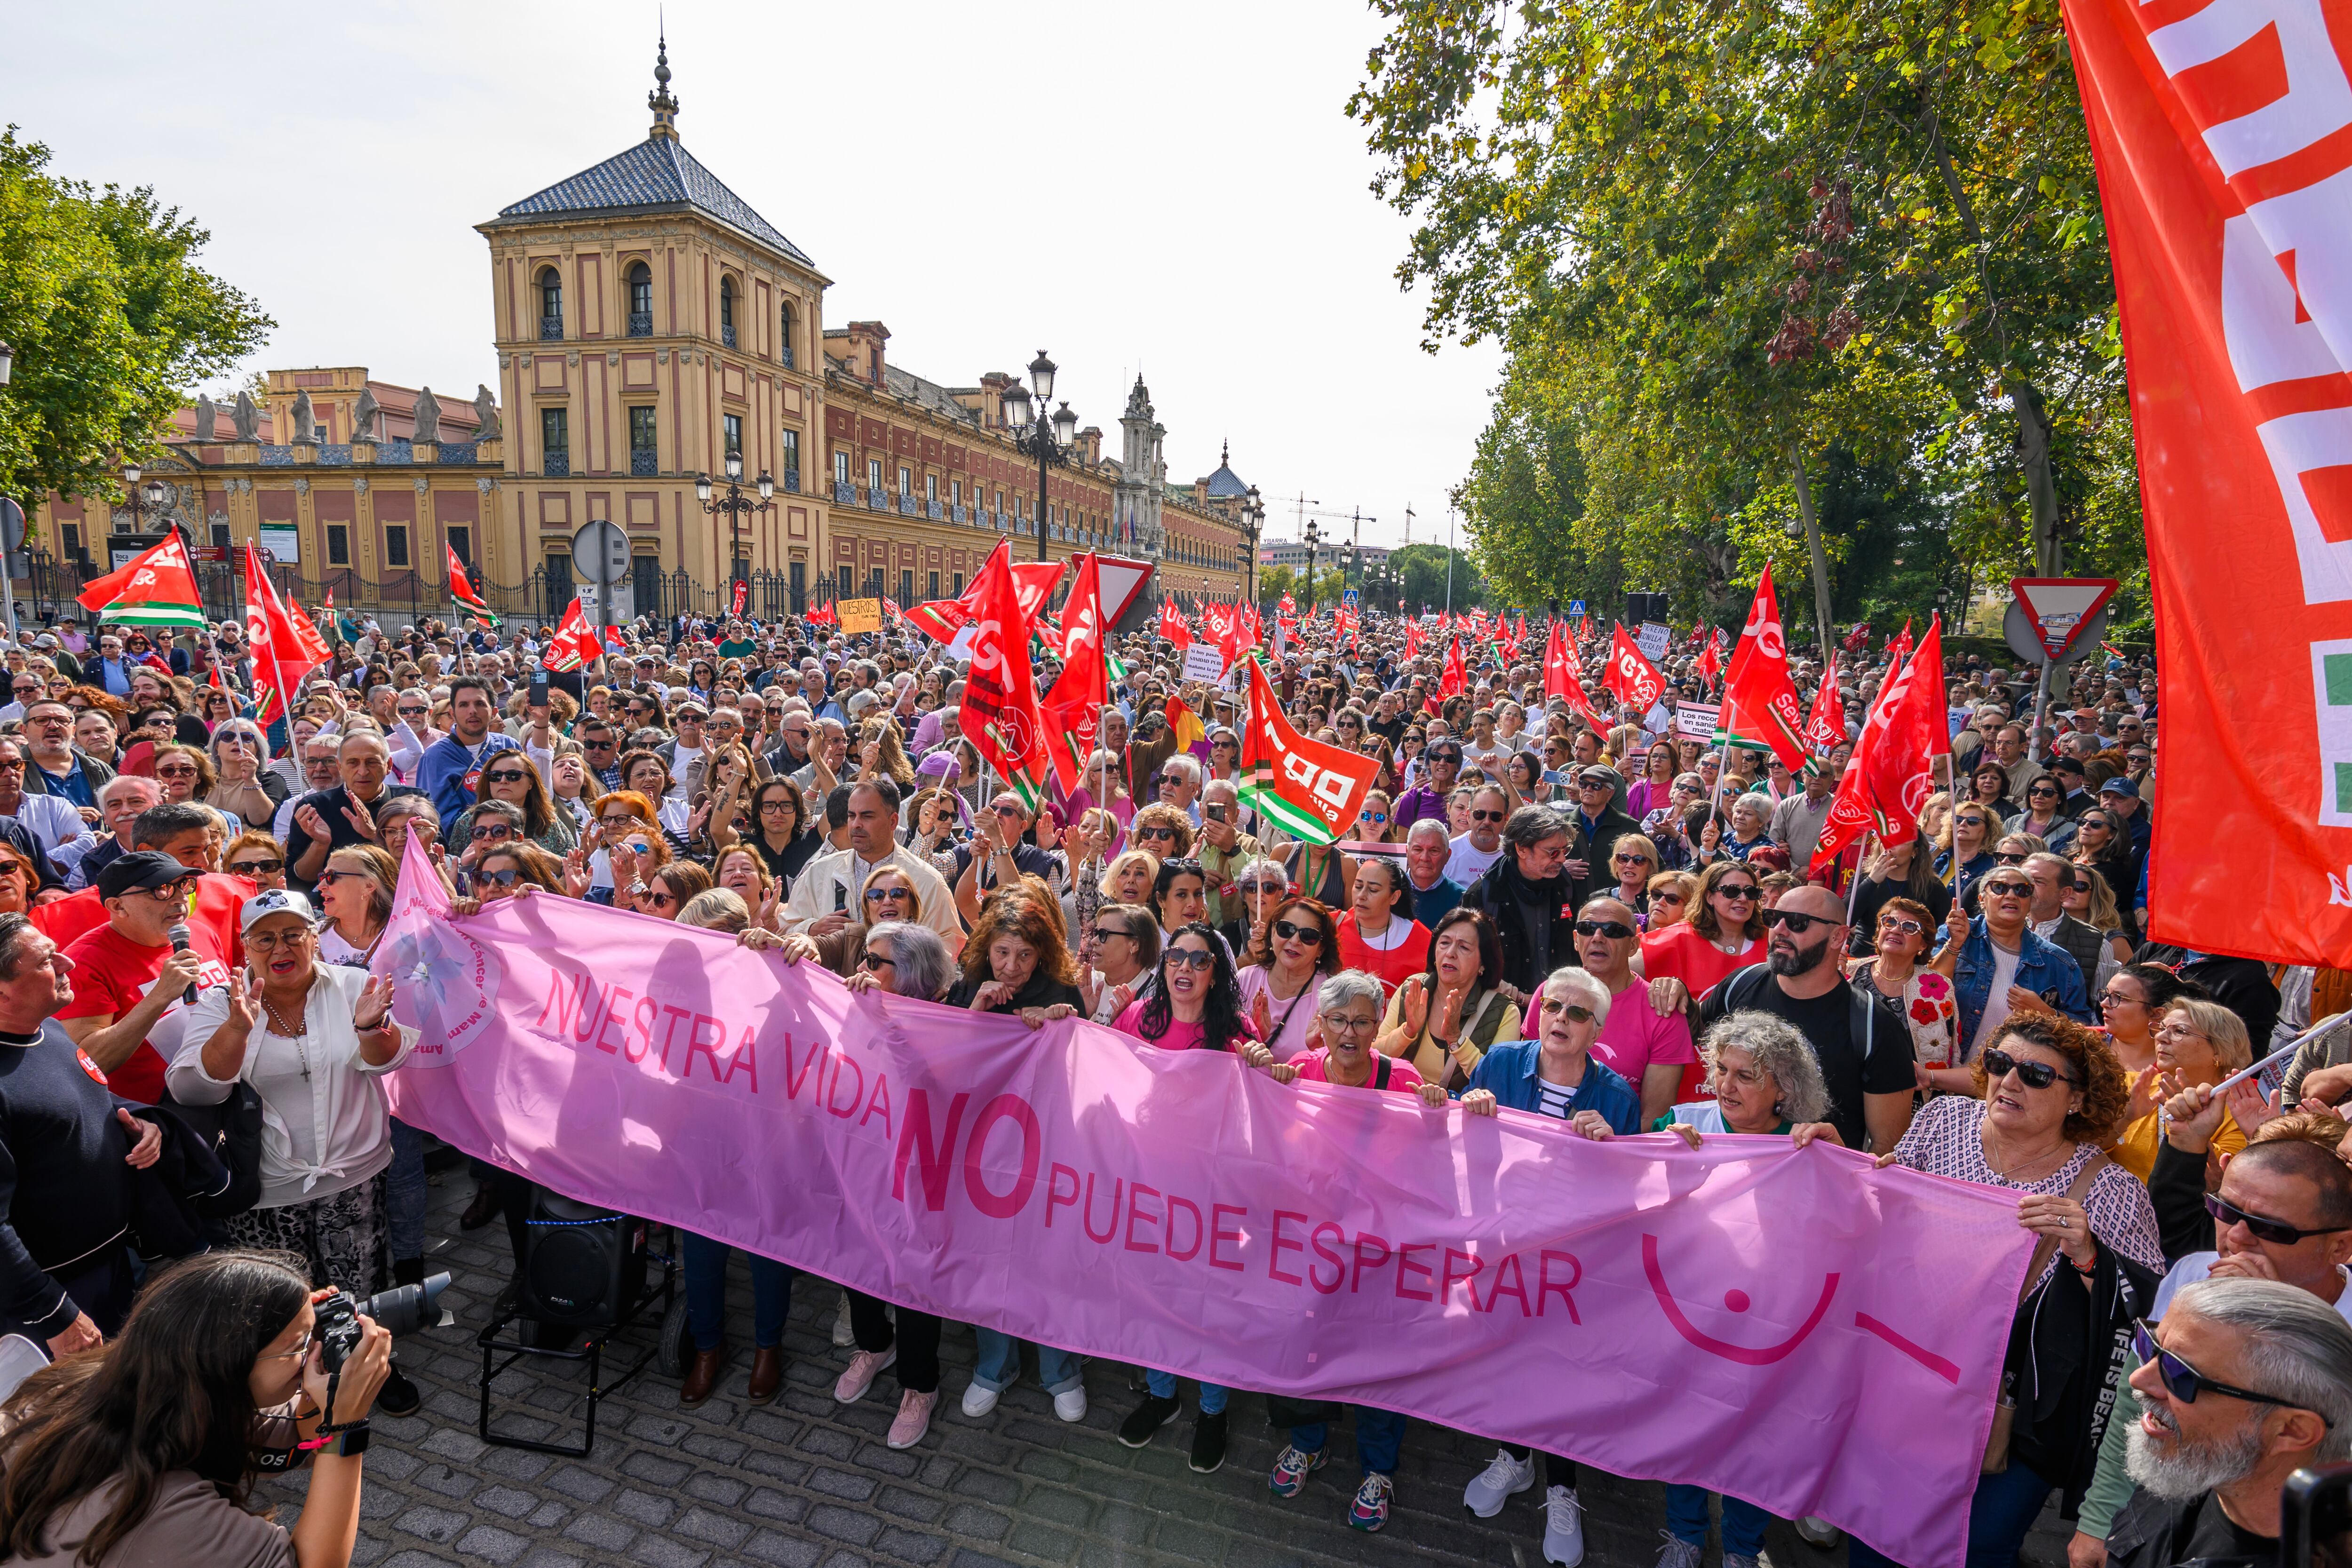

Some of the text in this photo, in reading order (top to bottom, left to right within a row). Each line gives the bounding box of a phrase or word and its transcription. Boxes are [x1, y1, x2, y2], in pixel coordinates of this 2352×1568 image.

[839, 600, 876, 615] NUESTROS
[853, 621, 880, 631] PRIVADA
[1643, 624, 1669, 635] MORENO
[1640, 632, 1662, 643] BONILLA
[1638, 641, 1655, 650] FUERA
[1641, 650, 1660, 660] VILLA
[470, 941, 486, 990] Cáncer
[447, 1011, 482, 1040] Mam
[2267, 1054, 2283, 1082] ÚBLICA
[536, 968, 1581, 1325] NUESTRA VIDA NO PUEDE ESPERAR
[2110, 1327, 2133, 1363] IFE
